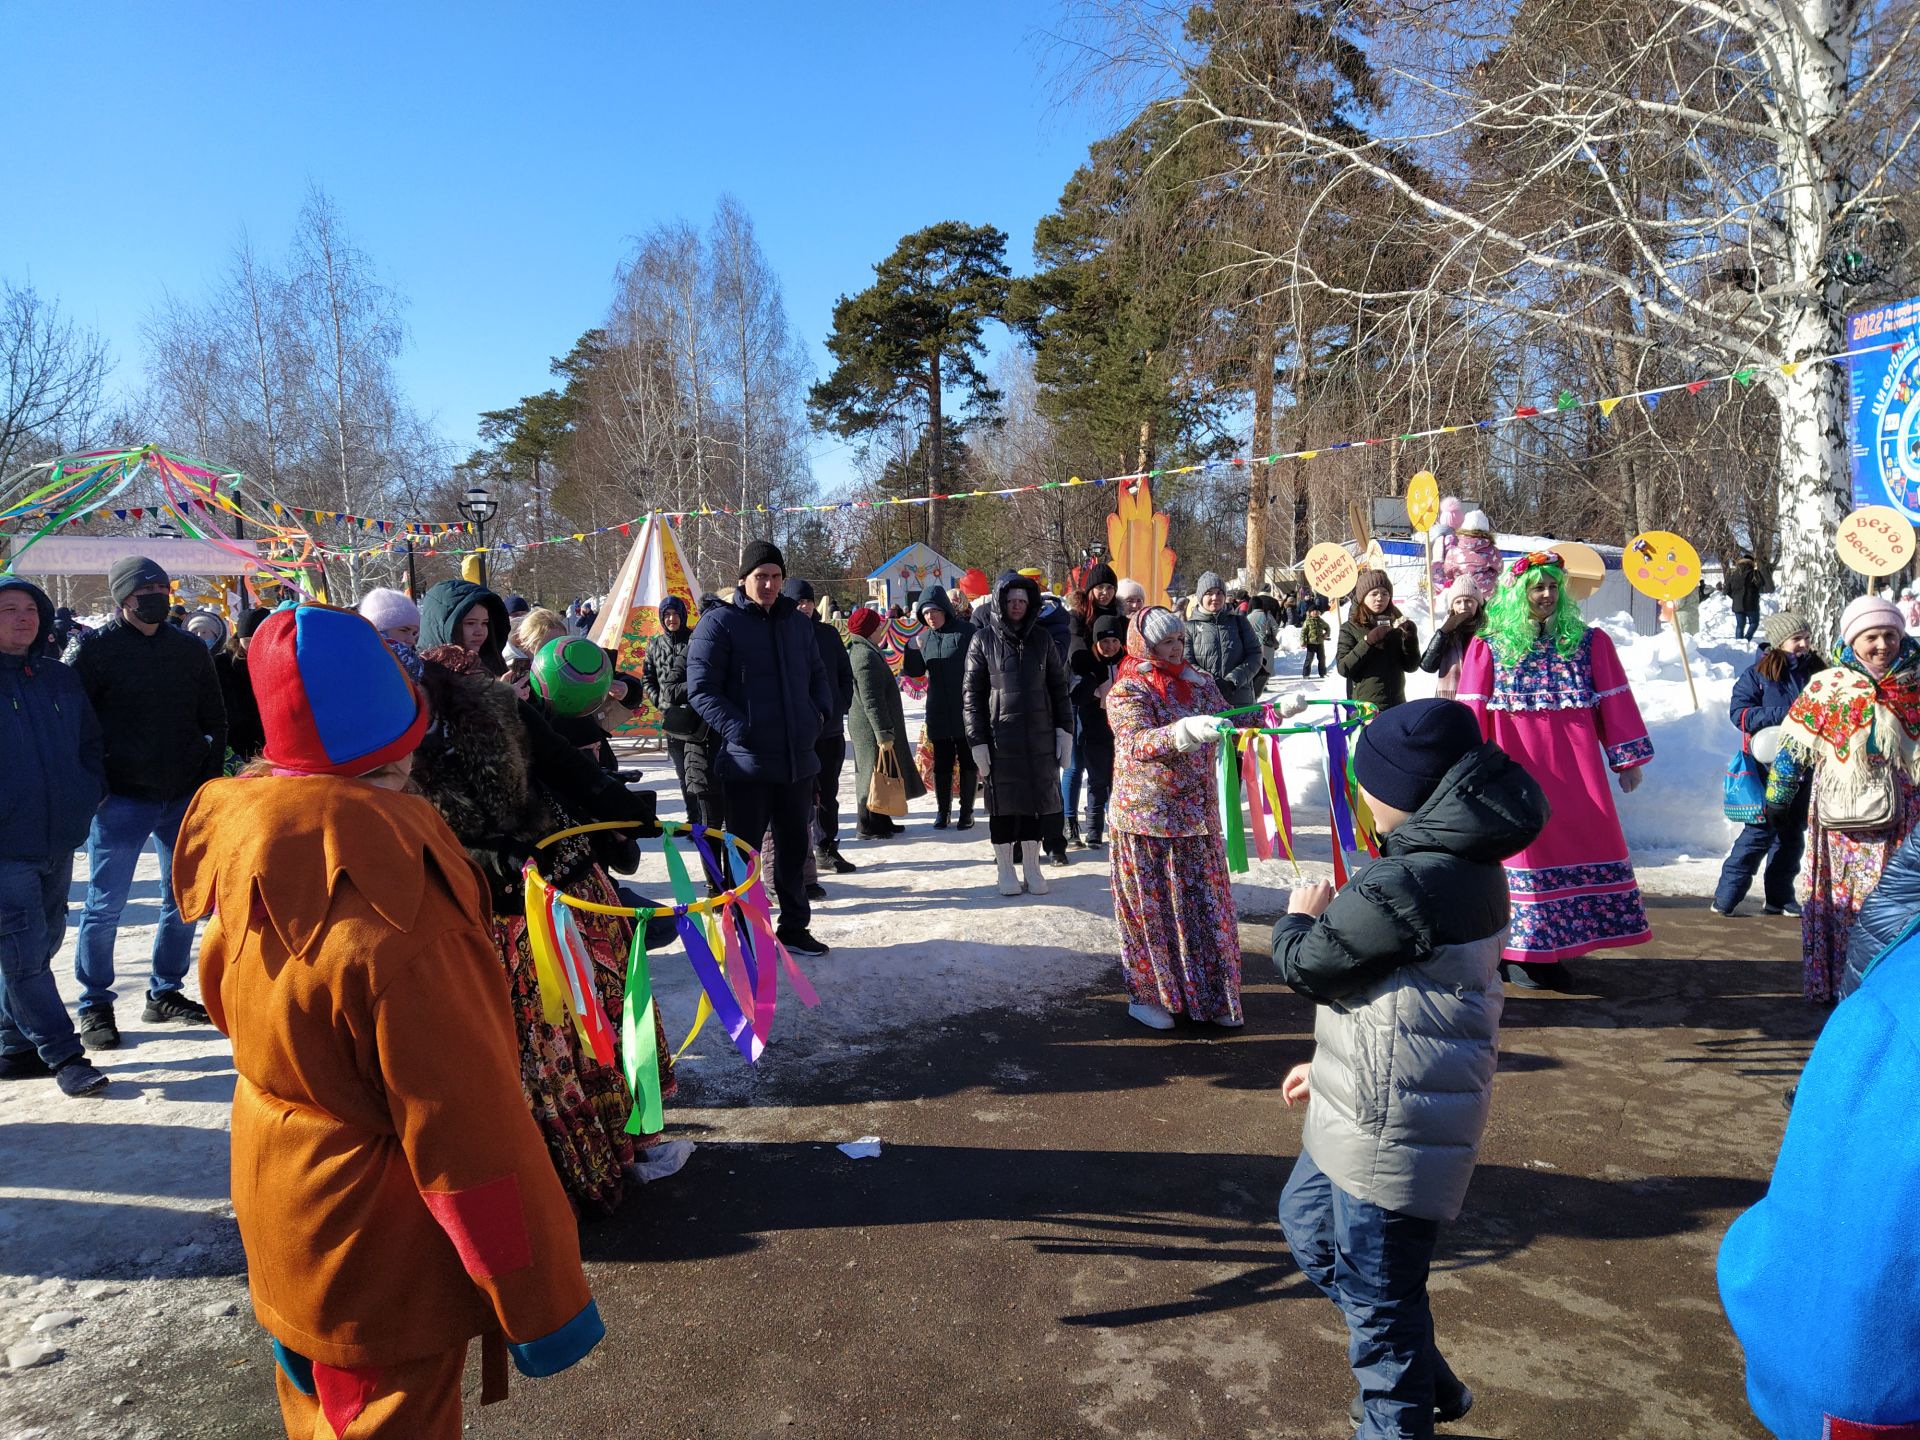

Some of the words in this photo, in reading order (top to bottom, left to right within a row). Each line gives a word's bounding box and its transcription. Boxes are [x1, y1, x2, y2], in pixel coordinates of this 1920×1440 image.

[1853, 310, 1884, 340] 2022
[1315, 554, 1347, 587] ликует
[1323, 583, 1332, 592] и
